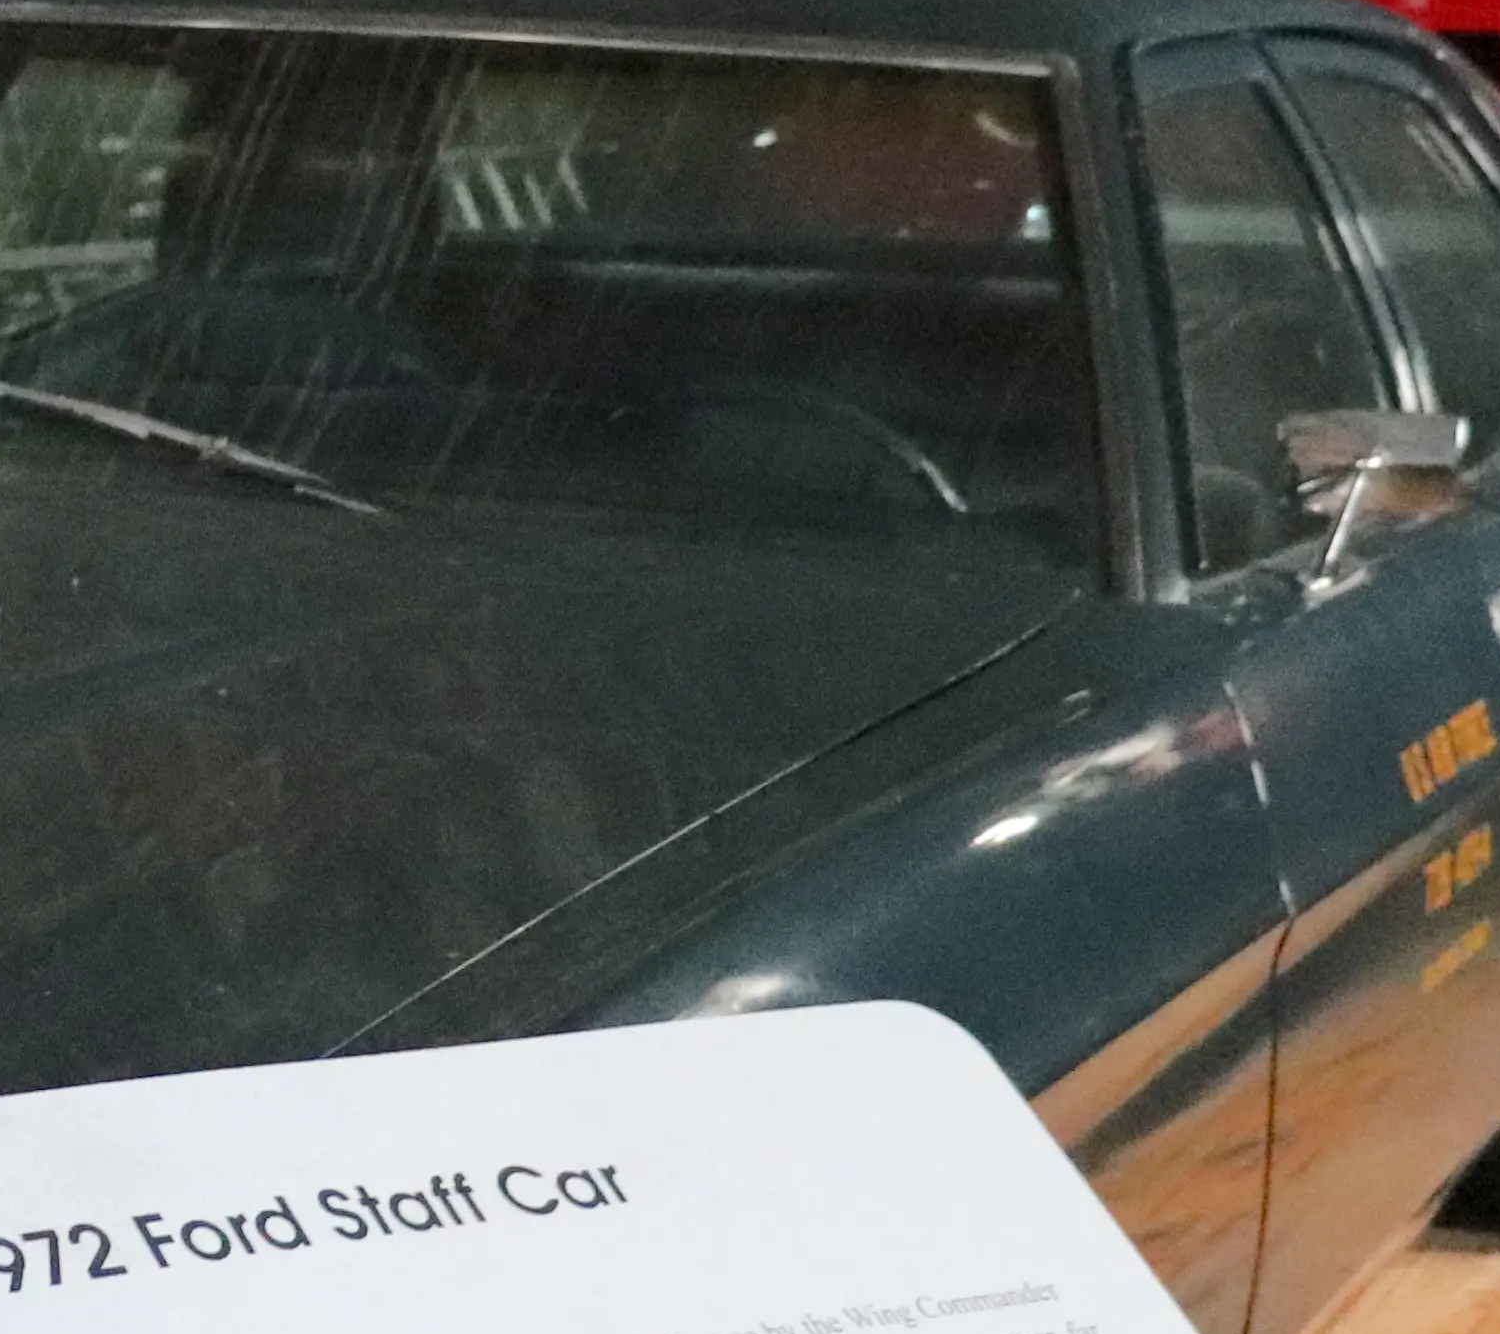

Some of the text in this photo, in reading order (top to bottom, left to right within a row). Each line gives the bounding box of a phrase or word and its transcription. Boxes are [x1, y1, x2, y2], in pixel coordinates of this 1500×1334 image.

[129, 1194, 312, 1269] Ford
[316, 1171, 487, 1241] Staff
[495, 1164, 629, 1216] Car
[842, 1303, 917, 1329] Wing
[915, 1282, 1058, 1318] Commander
